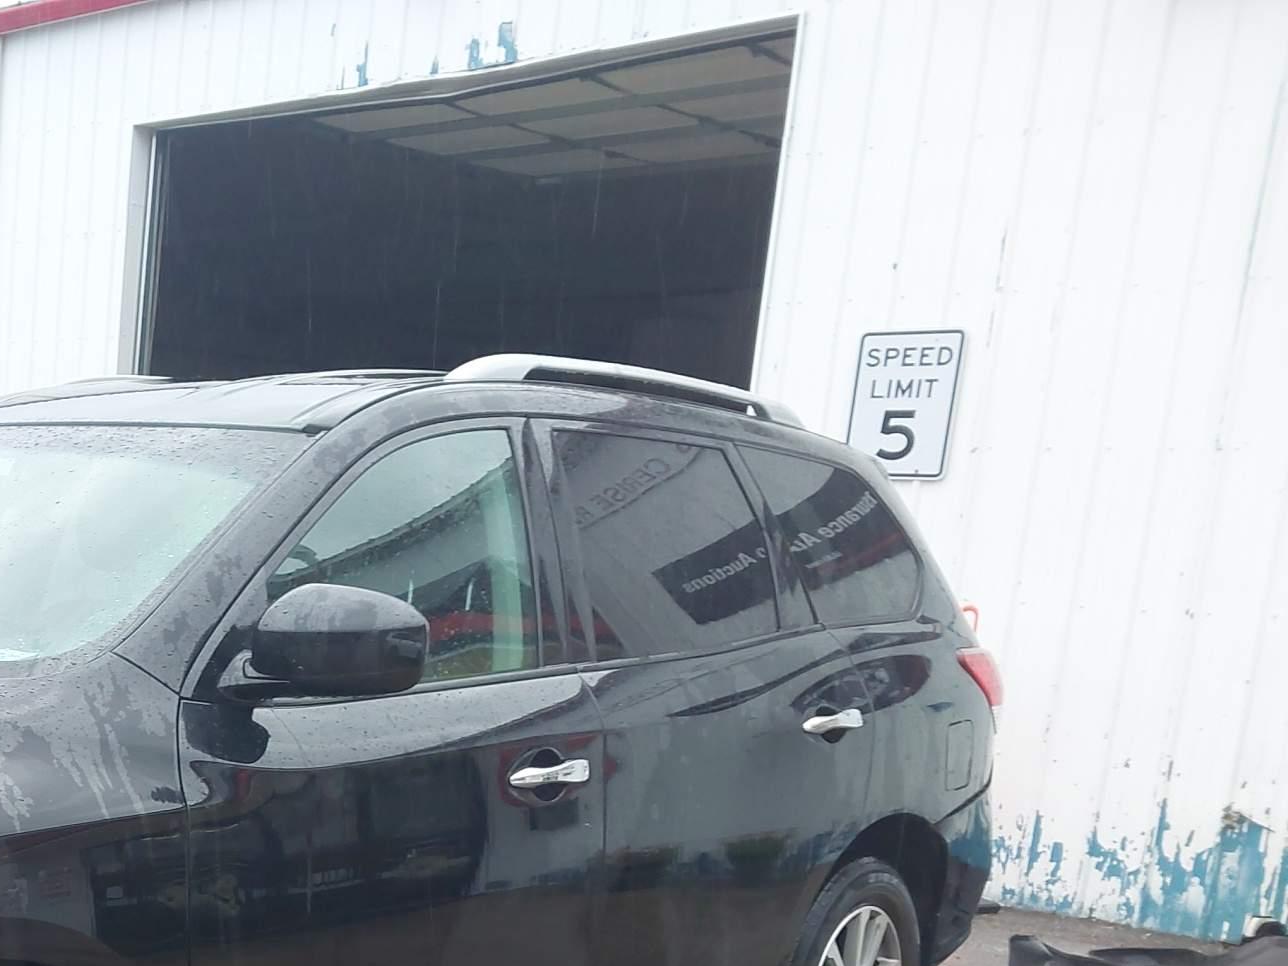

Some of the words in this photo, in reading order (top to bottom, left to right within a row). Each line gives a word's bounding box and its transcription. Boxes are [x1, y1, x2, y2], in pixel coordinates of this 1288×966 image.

[866, 346, 953, 367] SPEED
[870, 379, 939, 399] LIMIT
[876, 410, 916, 461] 5
